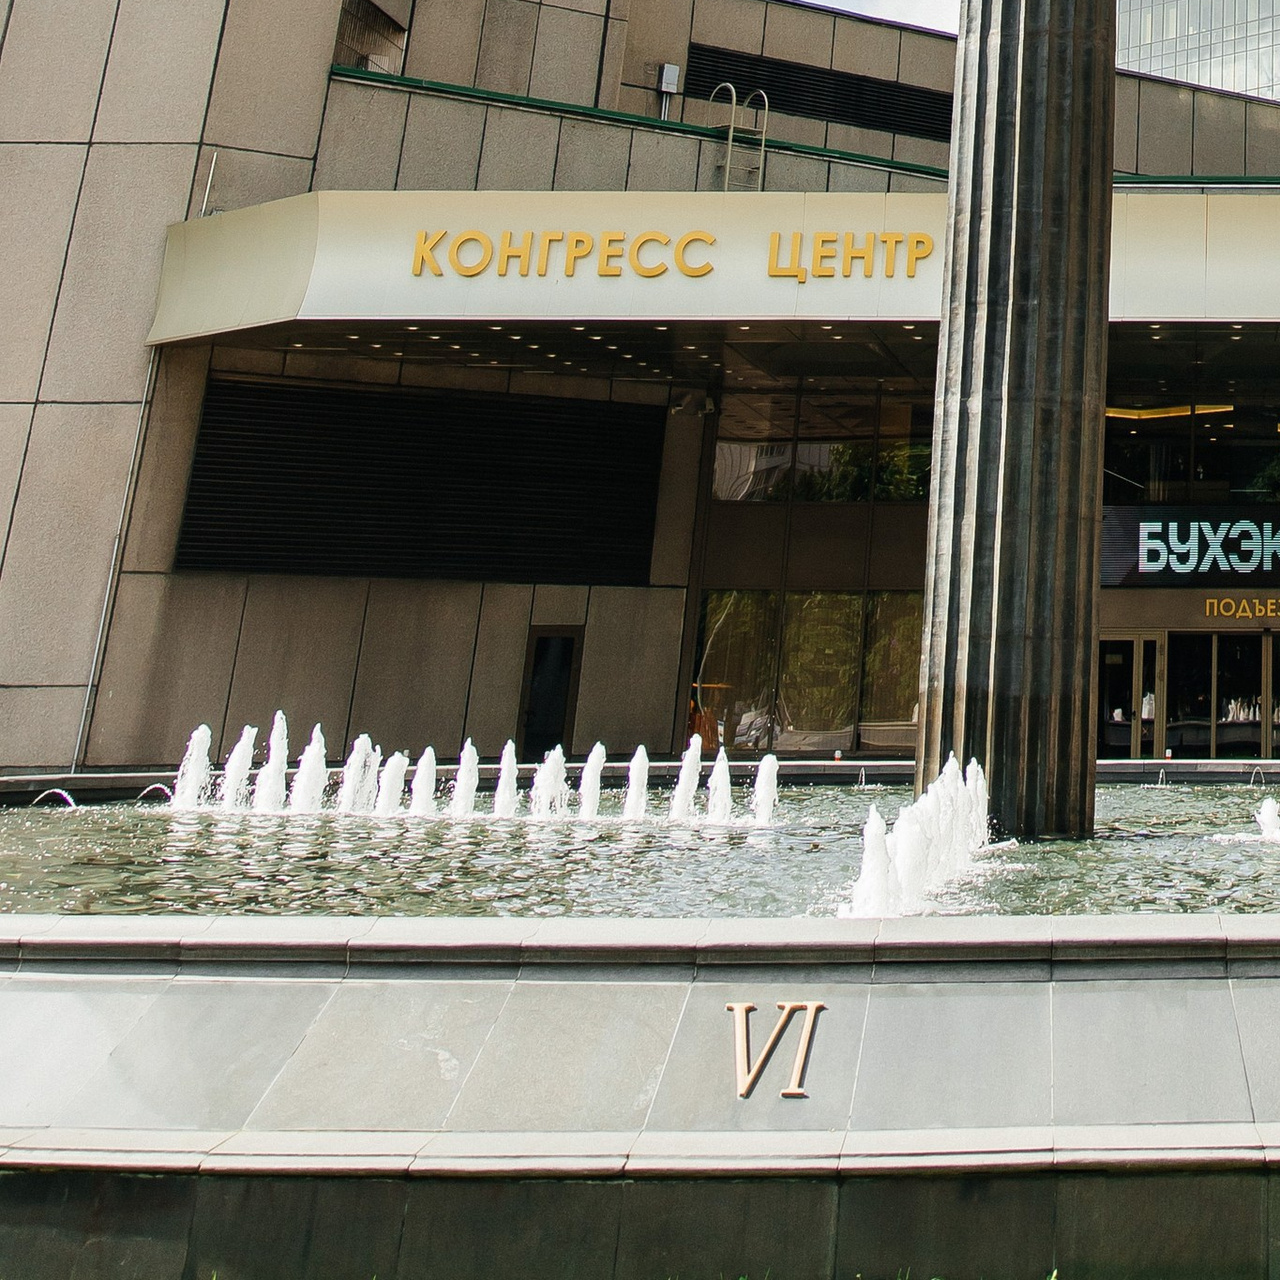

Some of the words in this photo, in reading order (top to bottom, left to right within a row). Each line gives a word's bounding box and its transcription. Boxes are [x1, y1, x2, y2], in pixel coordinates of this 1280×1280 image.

[412, 229, 717, 278] КОНГРЕСС
[768, 232, 934, 284] ЦЕНТР
[725, 1001, 826, 1099] VI
